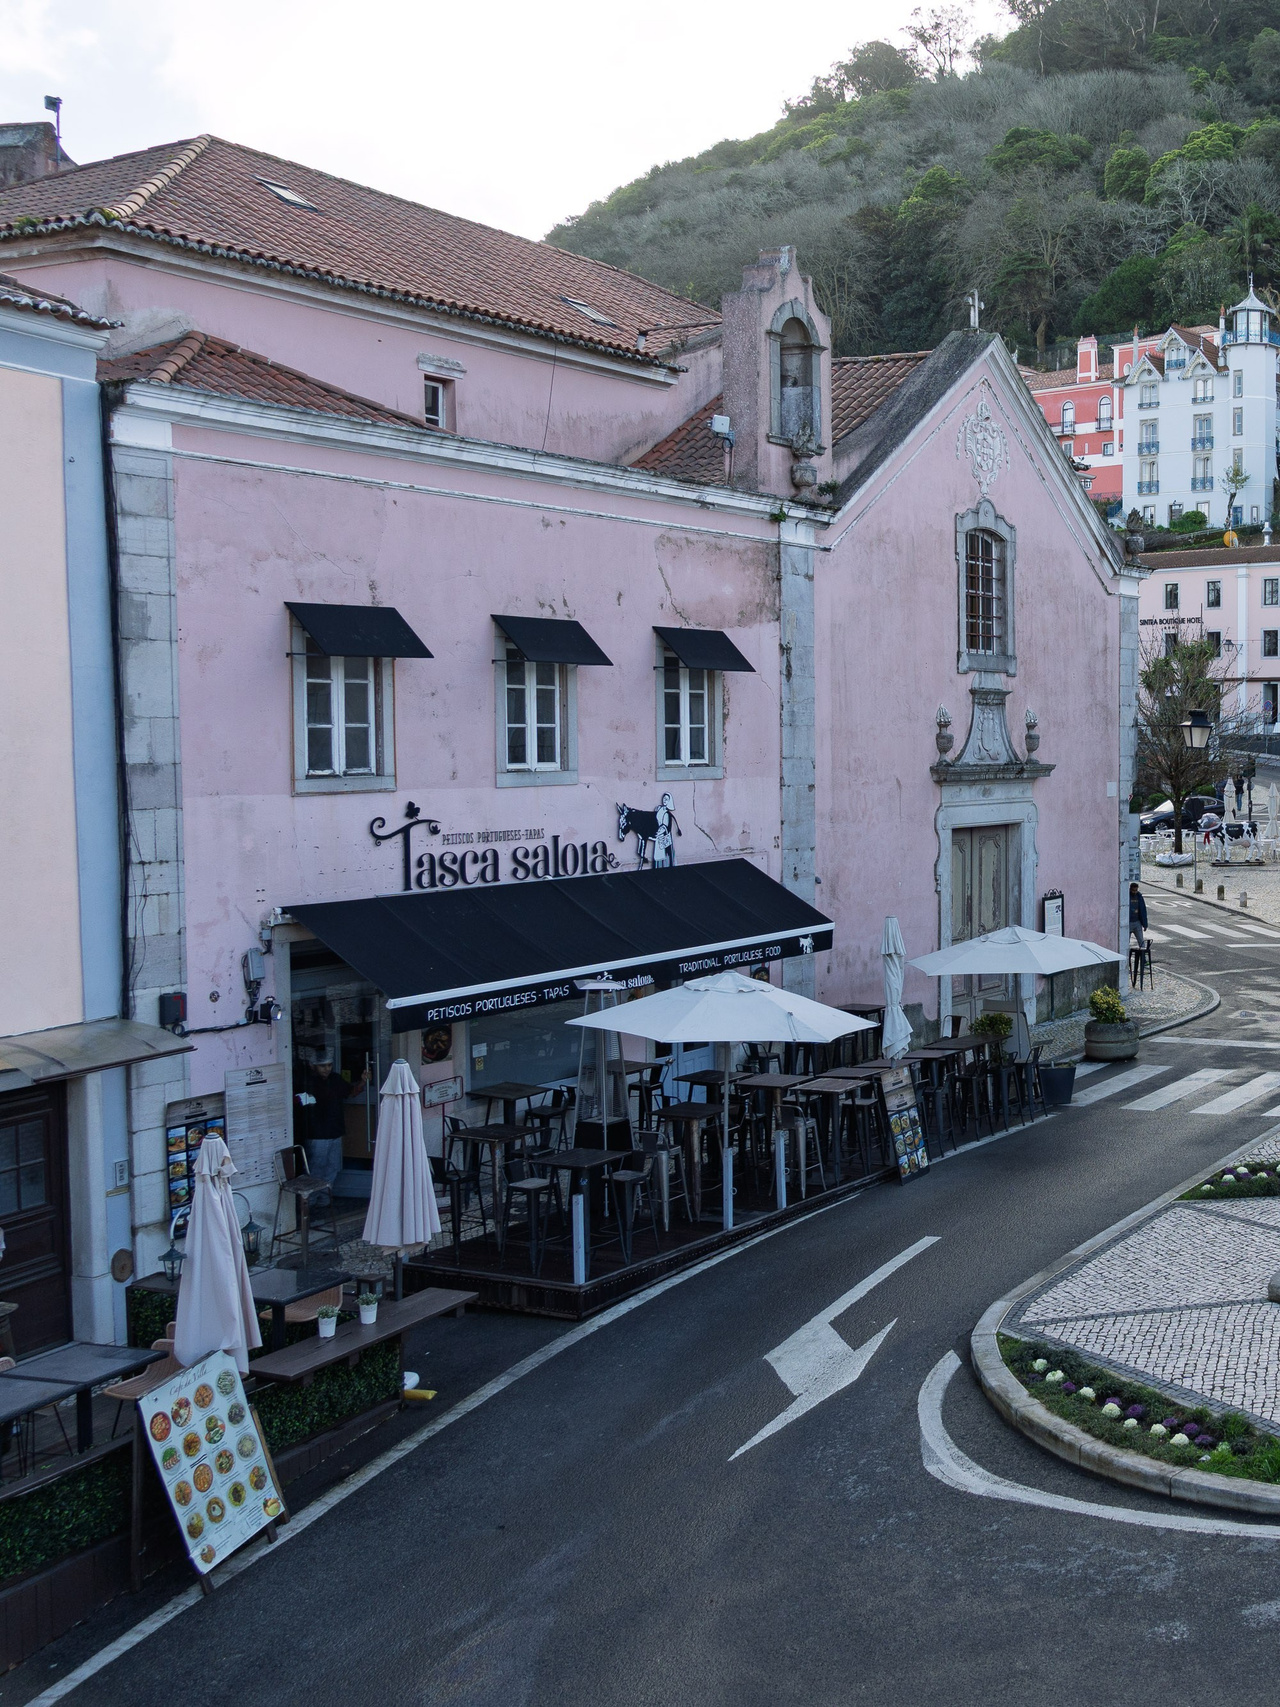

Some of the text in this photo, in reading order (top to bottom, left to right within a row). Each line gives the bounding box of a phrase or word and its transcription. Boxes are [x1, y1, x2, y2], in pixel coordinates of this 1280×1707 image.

[1139, 618, 1159, 626] SINTRA
[369, 812, 501, 891] Tasca
[442, 830, 475, 846] PETISCOS
[678, 945, 783, 974] TRADITIONAL PORTUGUESE FOOD
[427, 1002, 473, 1022] PETISCOS
[475, 990, 538, 1013] PORTUGUESES
[543, 984, 570, 1000] TAPAS
